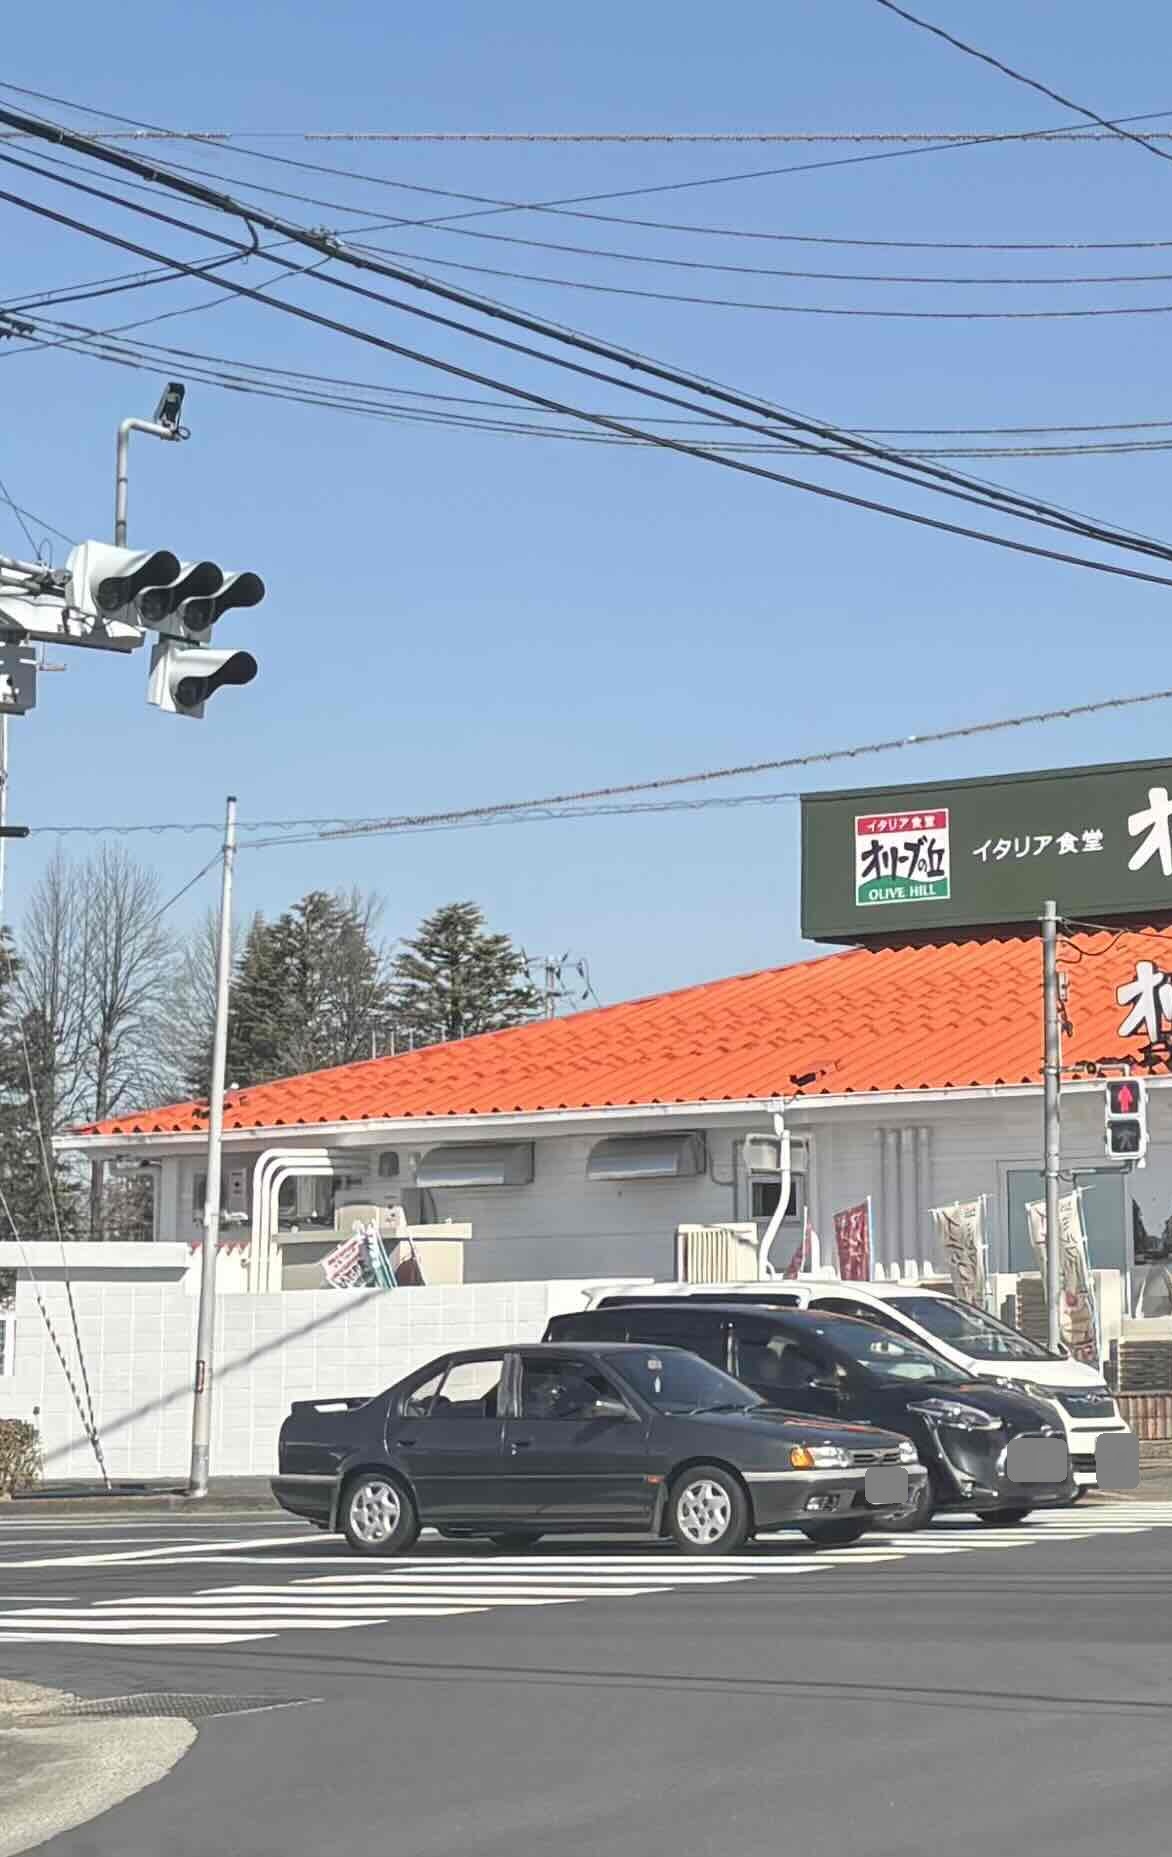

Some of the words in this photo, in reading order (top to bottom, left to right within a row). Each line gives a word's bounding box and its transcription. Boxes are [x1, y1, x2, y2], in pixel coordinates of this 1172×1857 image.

[867, 815, 935, 833] イタリア食堂
[861, 835, 945, 880] オリーブの丘
[972, 828, 1104, 864] イタリア食堂
[868, 888, 905, 901] OLIVE
[909, 884, 936, 898] HILL
